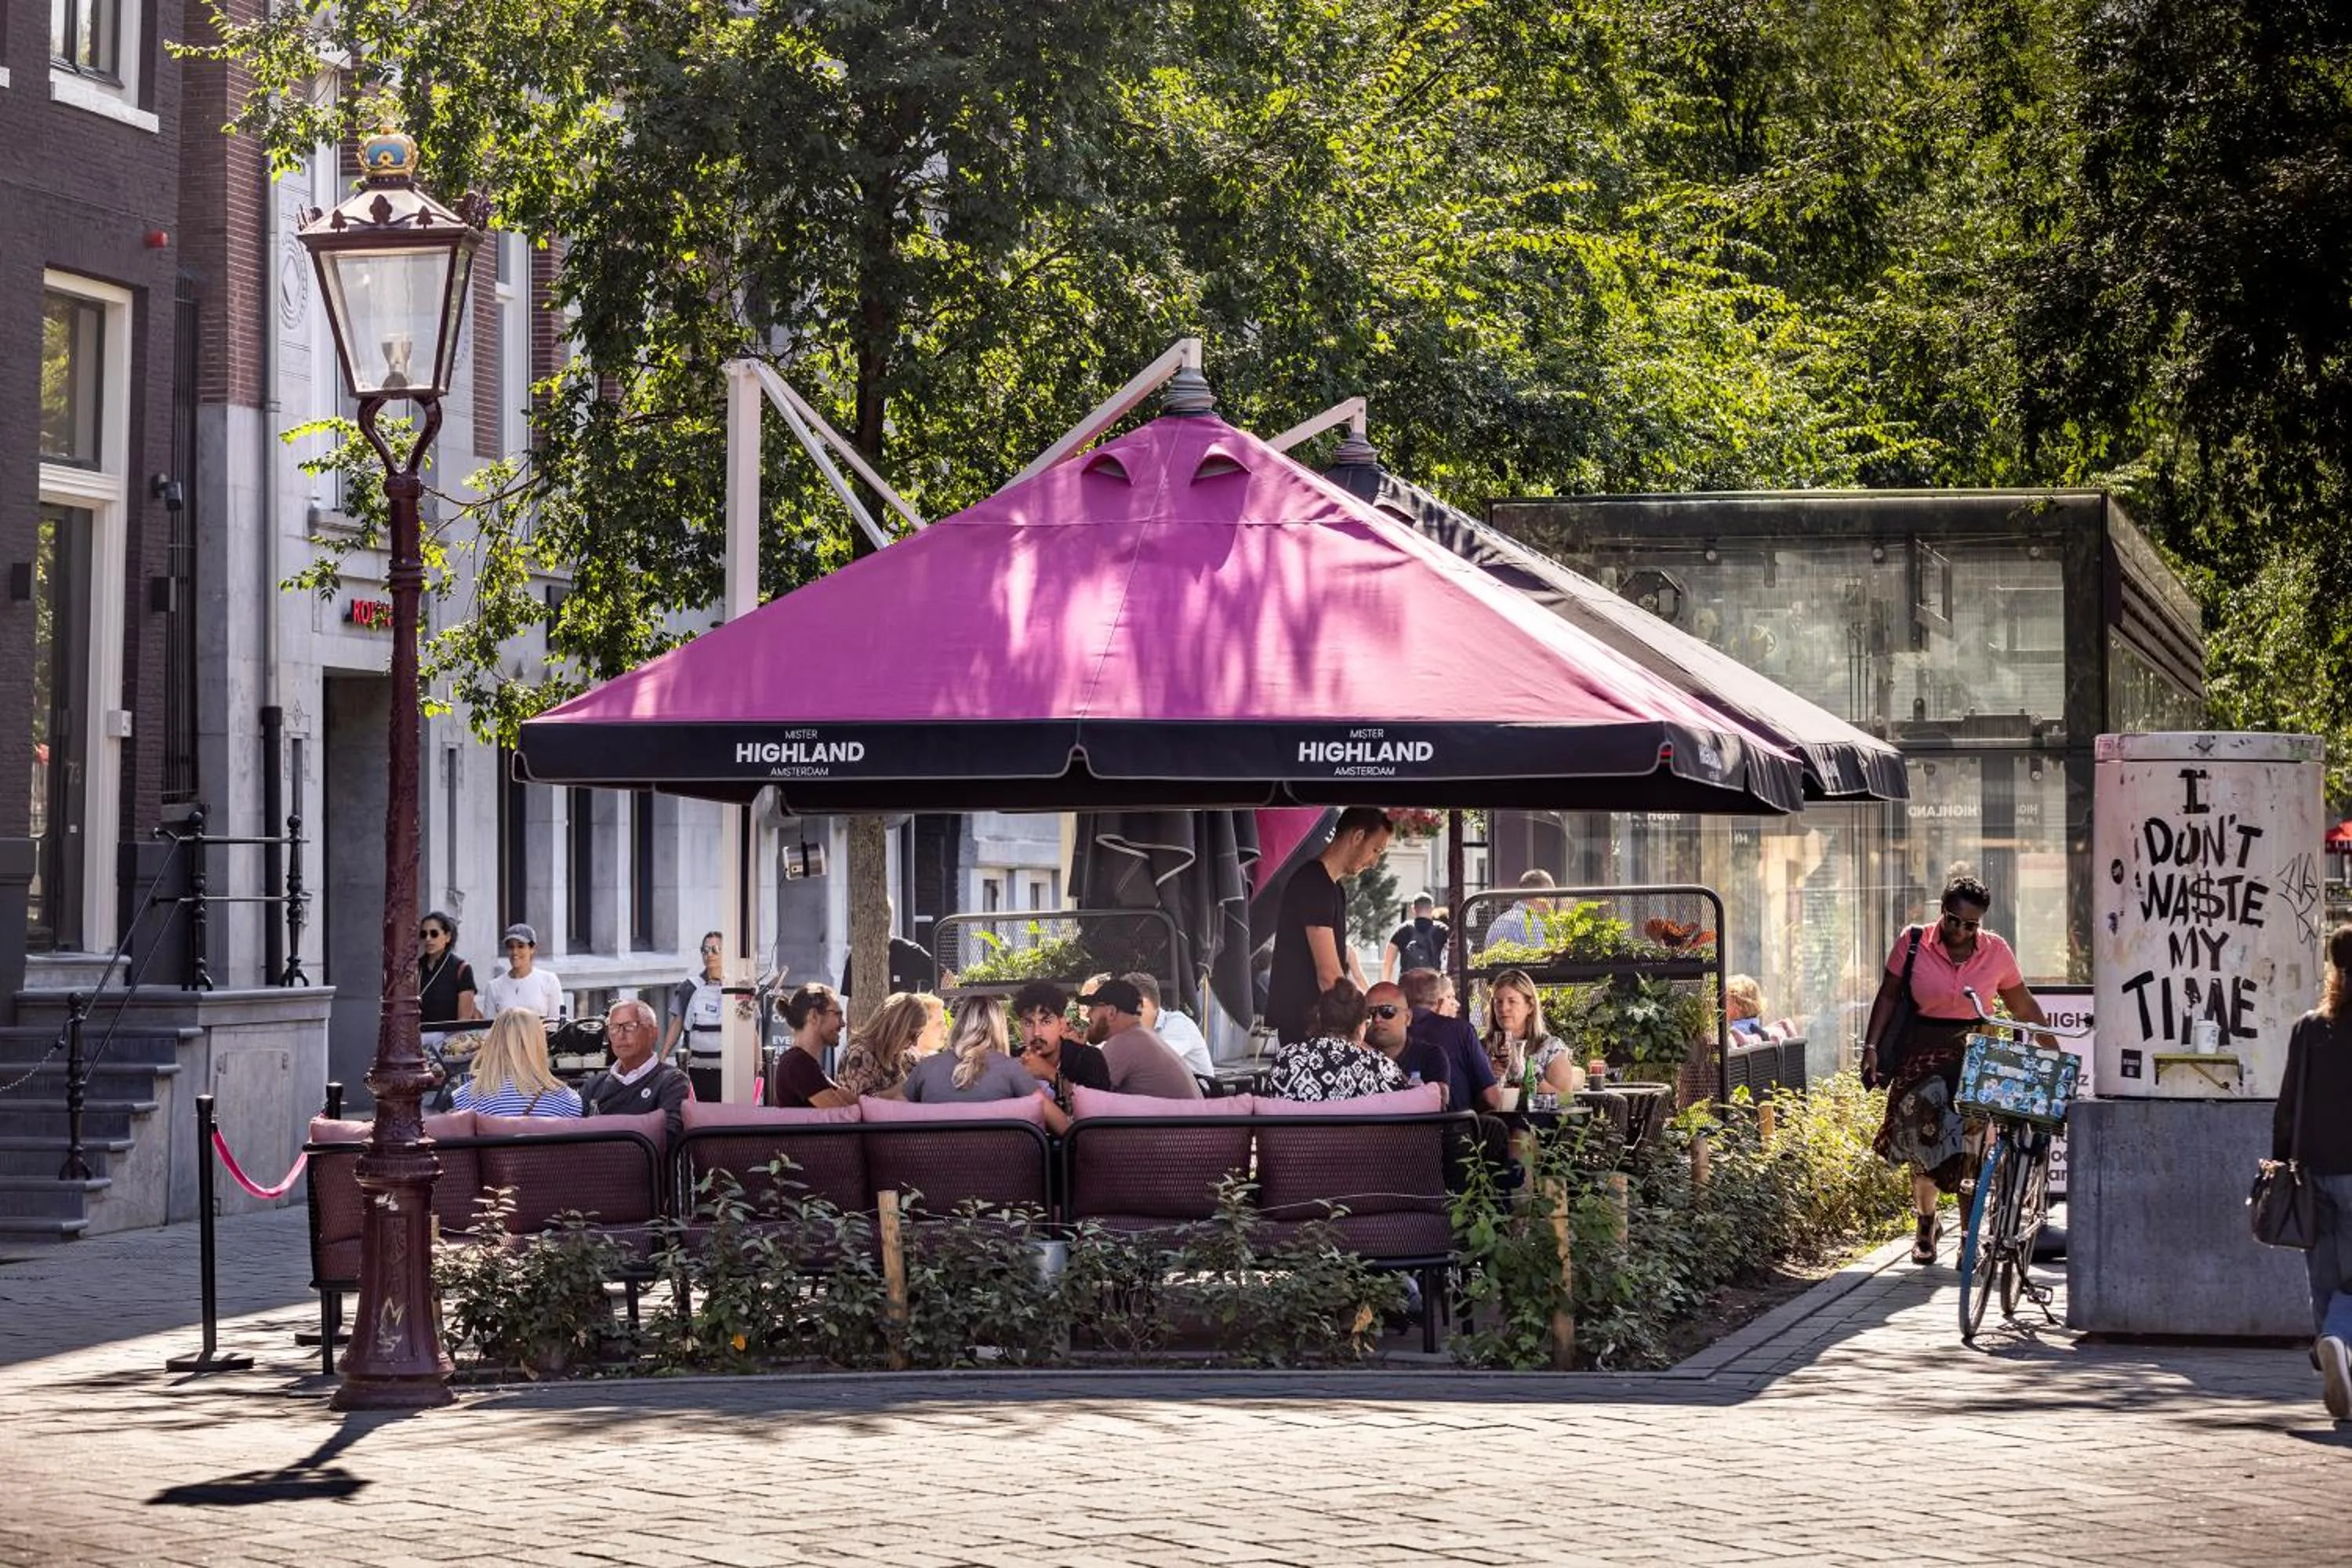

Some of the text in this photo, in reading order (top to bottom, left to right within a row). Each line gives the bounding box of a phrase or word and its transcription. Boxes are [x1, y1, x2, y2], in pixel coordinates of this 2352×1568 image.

[785, 729, 818, 739] MISTER
[1349, 728, 1385, 739] MISTER
[735, 742, 865, 763] HIGHLAND
[1298, 742, 1434, 763] HIGHLAND
[770, 766, 829, 777] AMSTERDAM
[1334, 766, 1396, 776] AMSTERDAM
[2178, 769, 2211, 815] I
[2143, 814, 2263, 869] DON'T
[2168, 926, 2230, 971] MY
[2122, 970, 2259, 1046] TIME
